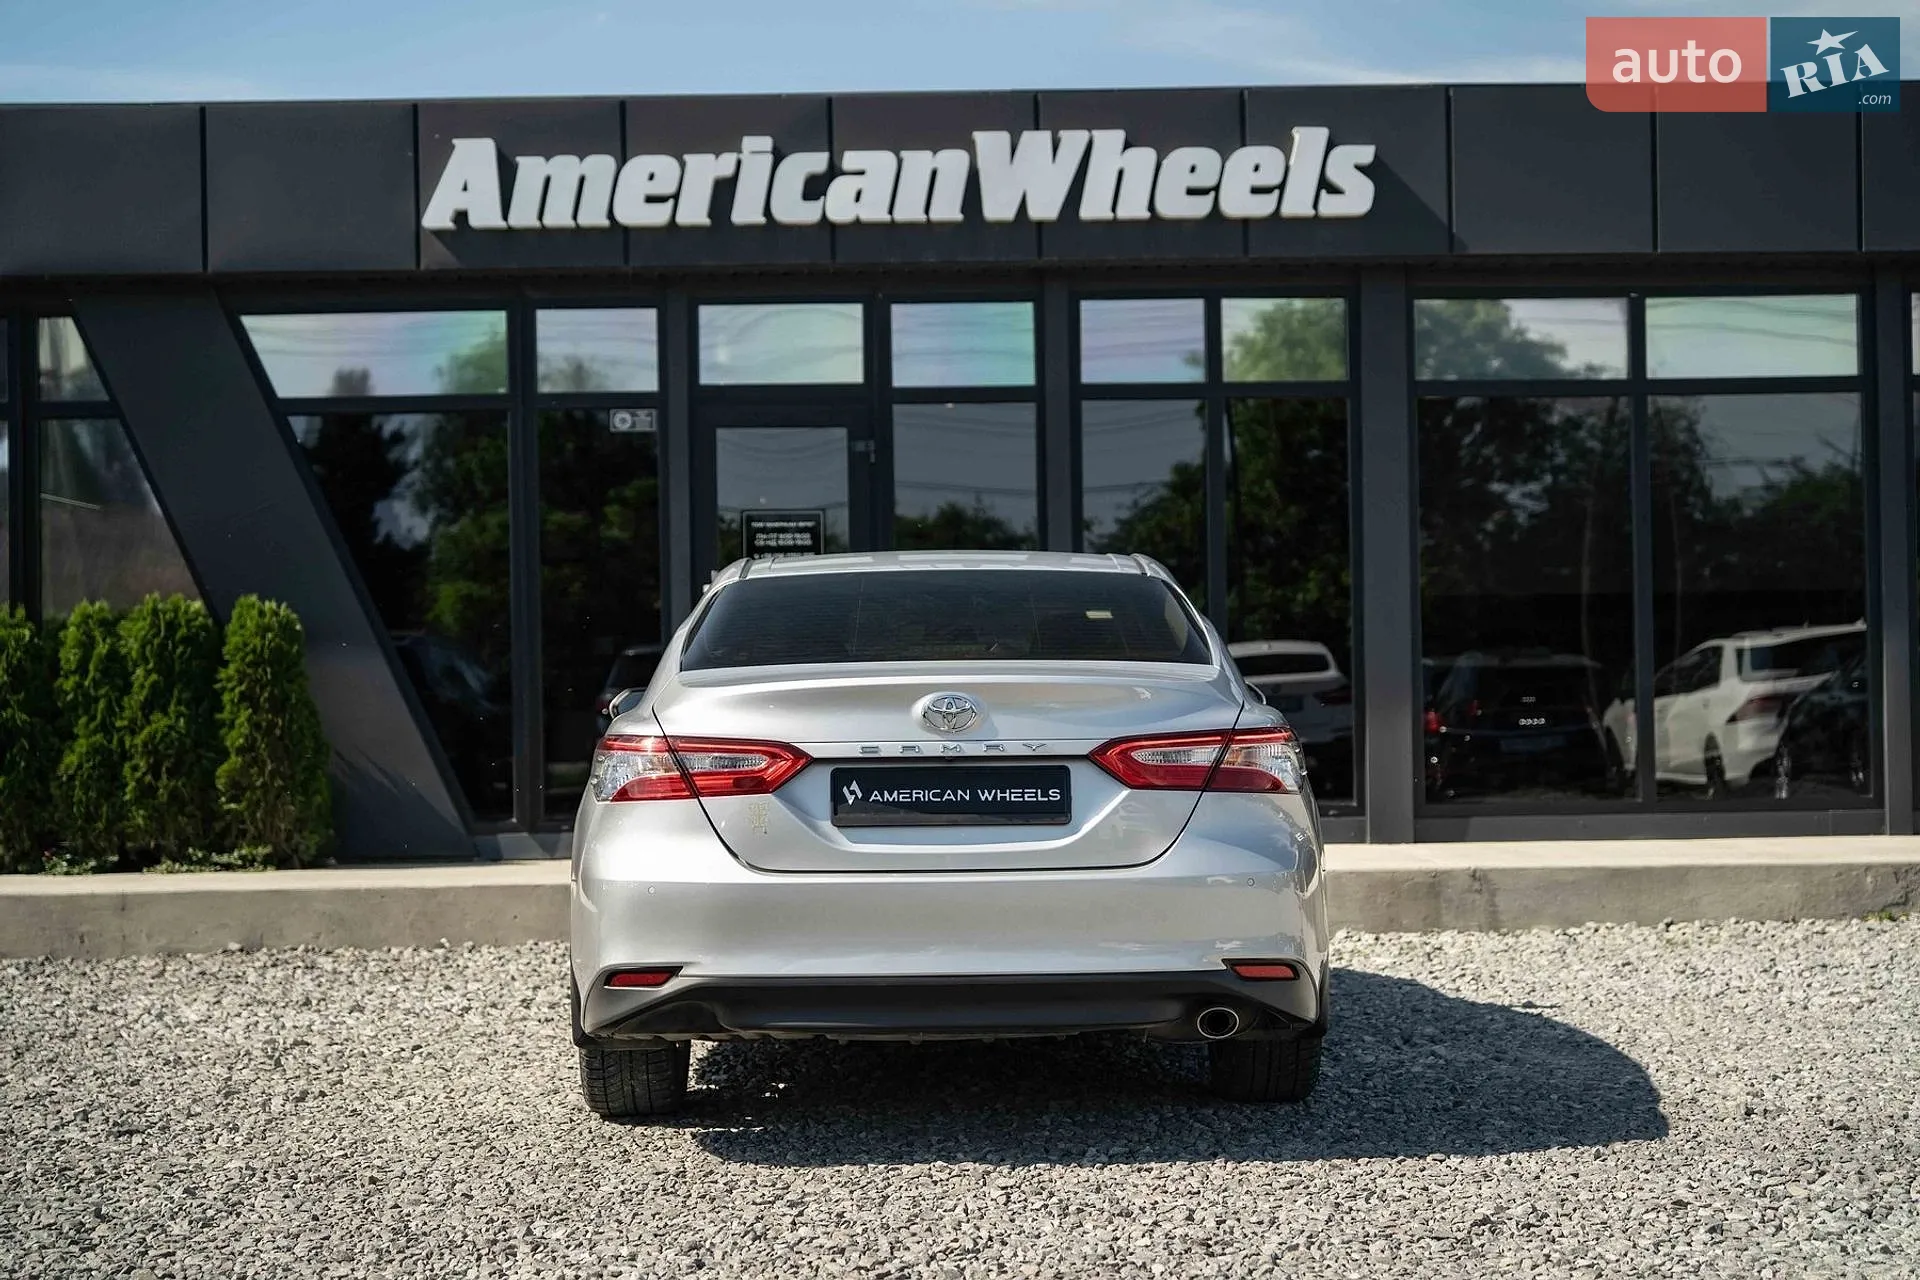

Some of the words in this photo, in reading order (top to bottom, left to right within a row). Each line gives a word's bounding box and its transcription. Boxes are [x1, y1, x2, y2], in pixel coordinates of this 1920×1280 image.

[421, 126, 1377, 230] AmericanWheels
[858, 743, 1047, 755] CAMRY
[868, 789, 970, 803] AMERICAN
[977, 788, 1061, 802] WHEELS
